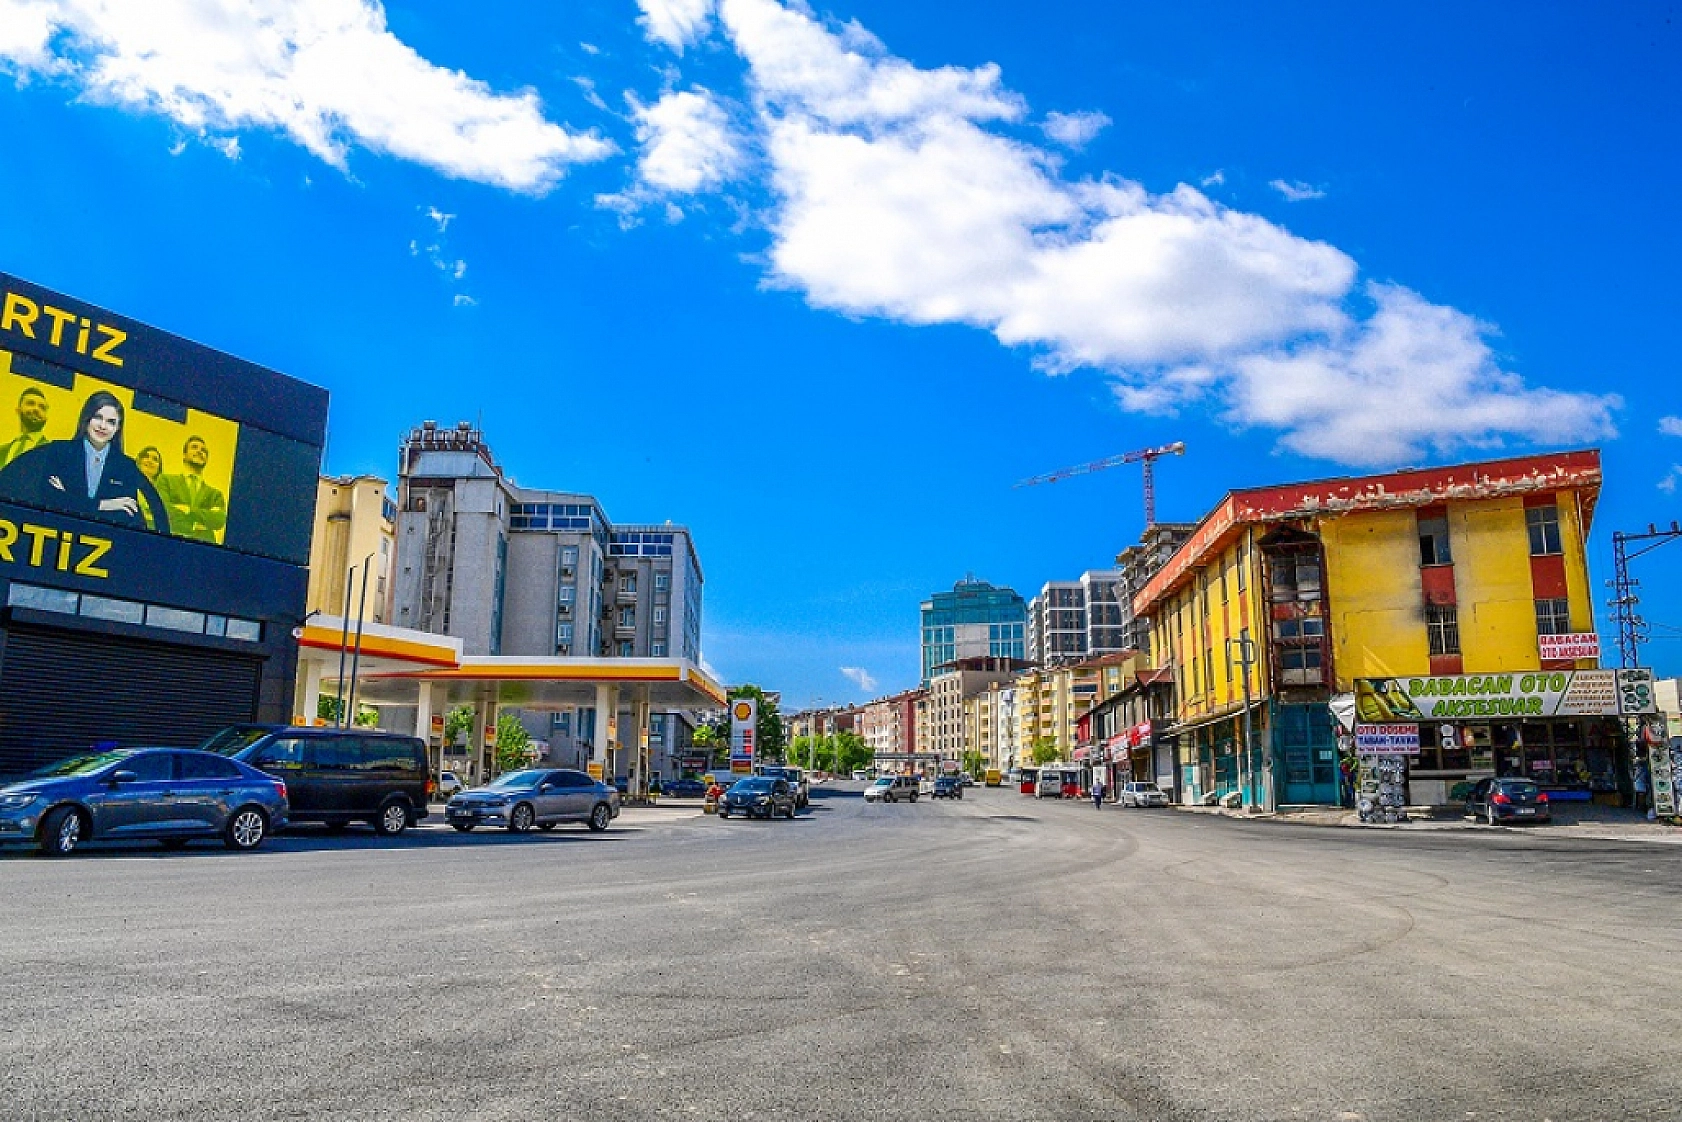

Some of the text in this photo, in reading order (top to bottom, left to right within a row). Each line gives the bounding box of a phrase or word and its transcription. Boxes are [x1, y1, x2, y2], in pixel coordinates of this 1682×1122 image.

[1408, 672, 1566, 697] BABACAN OTO
[1432, 695, 1543, 717] AKSESUAR
[1357, 725, 1377, 734] OTO
